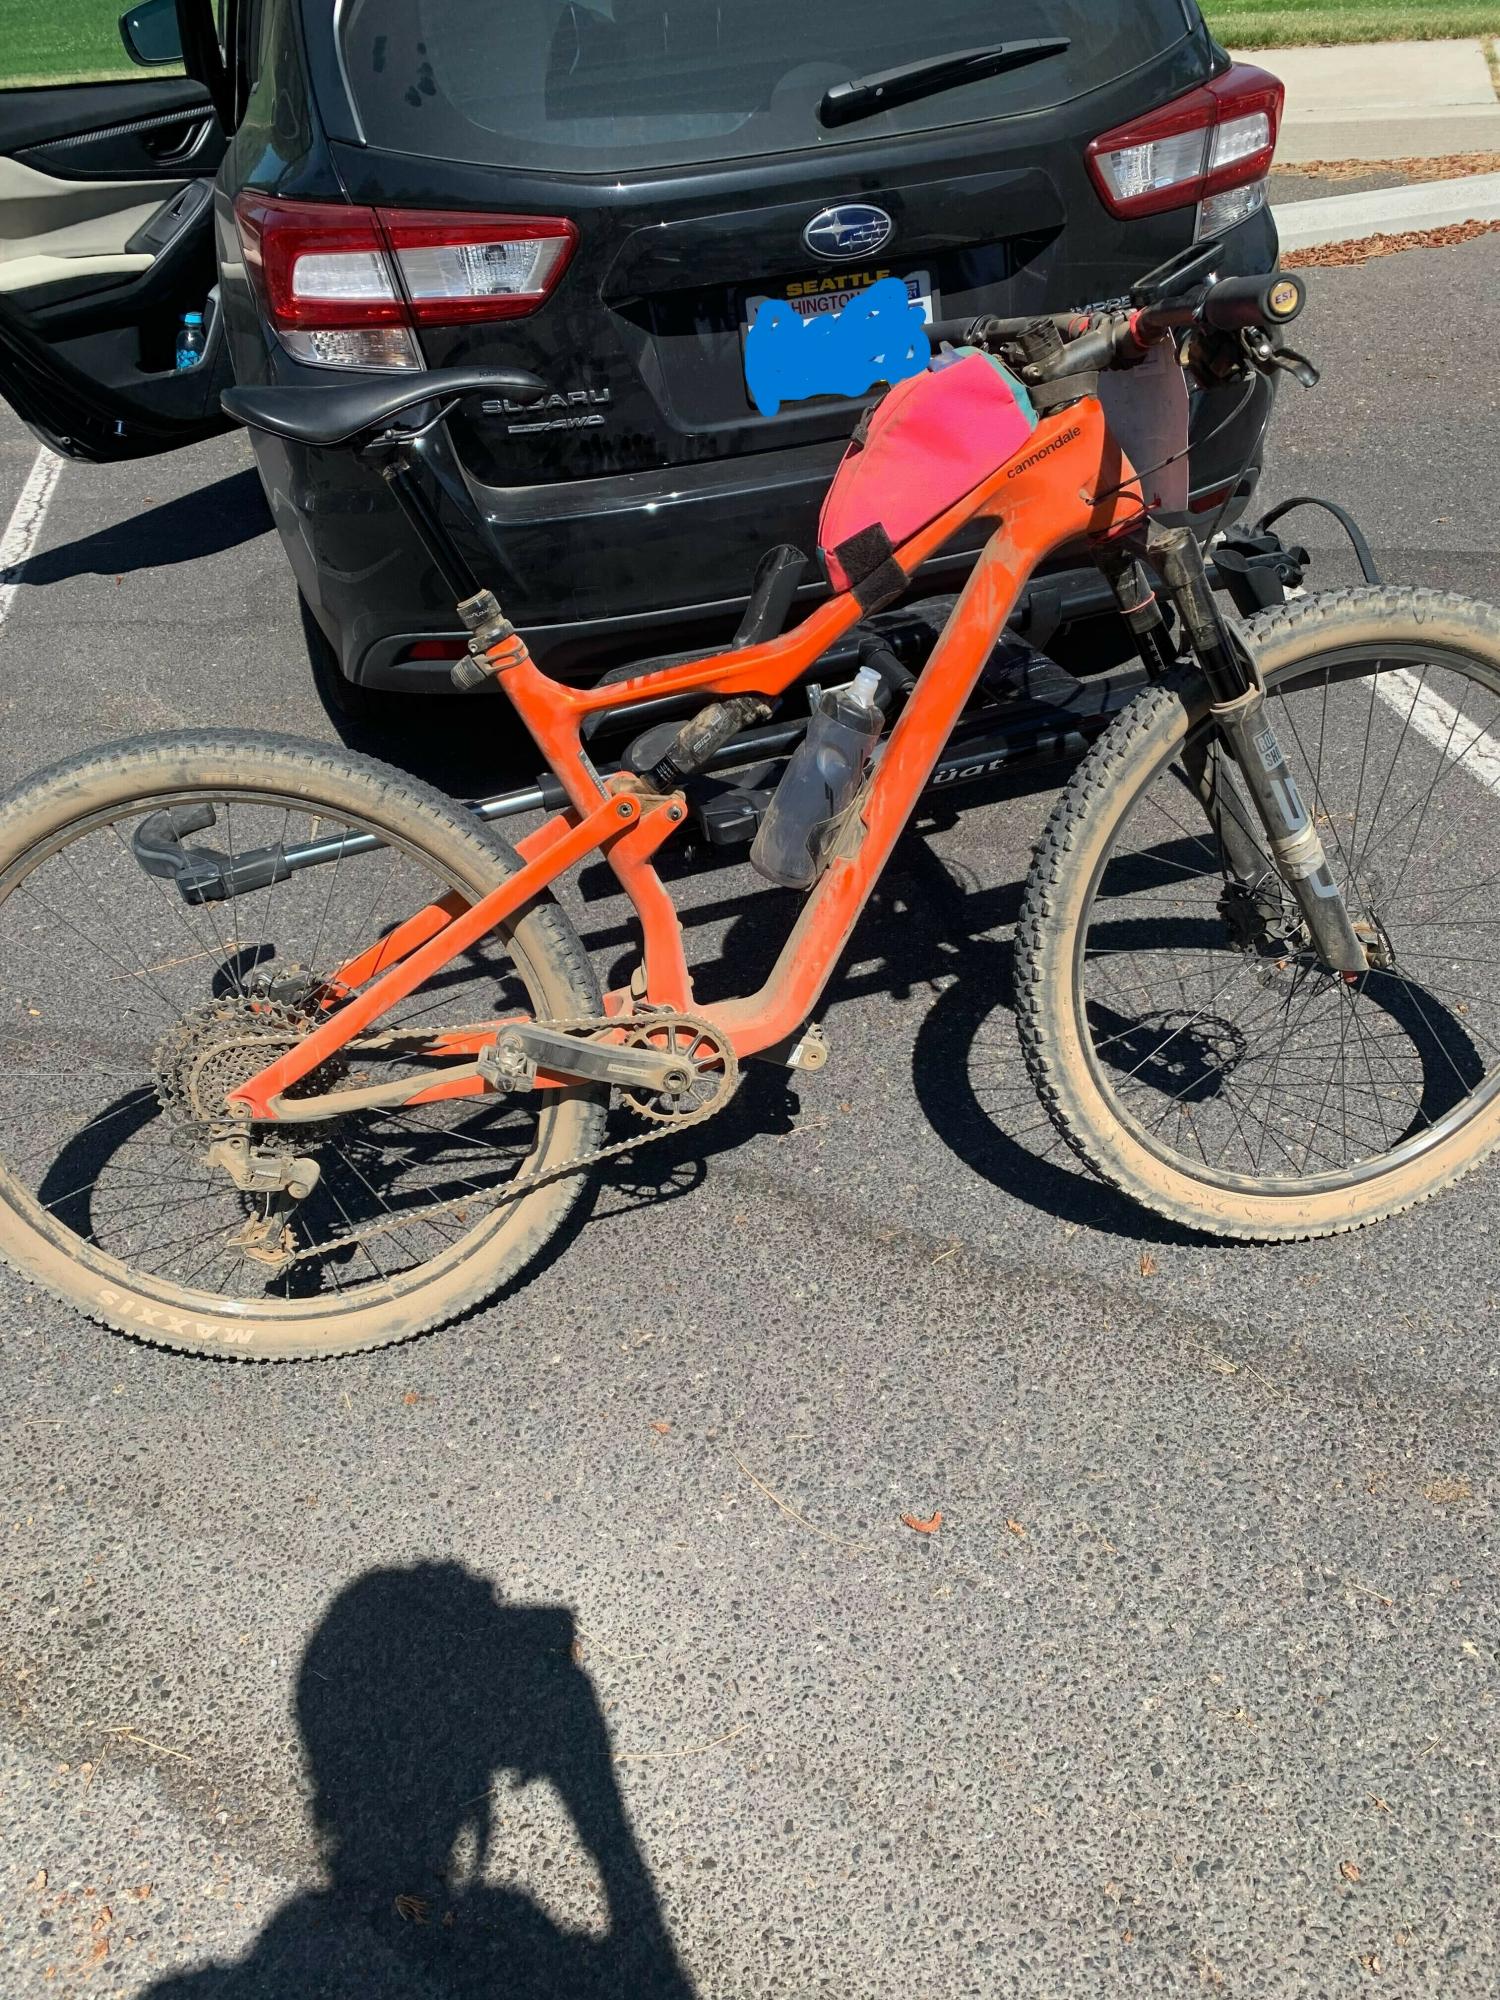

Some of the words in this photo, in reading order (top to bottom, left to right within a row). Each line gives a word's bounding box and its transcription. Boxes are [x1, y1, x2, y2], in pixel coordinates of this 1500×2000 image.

[786, 269, 891, 297] SEATTLE
[1275, 289, 1294, 304] ESI
[1007, 427, 1081, 479] cannondale
[932, 758, 1004, 785] üat
[100, 1290, 255, 1345] MAXXIS
